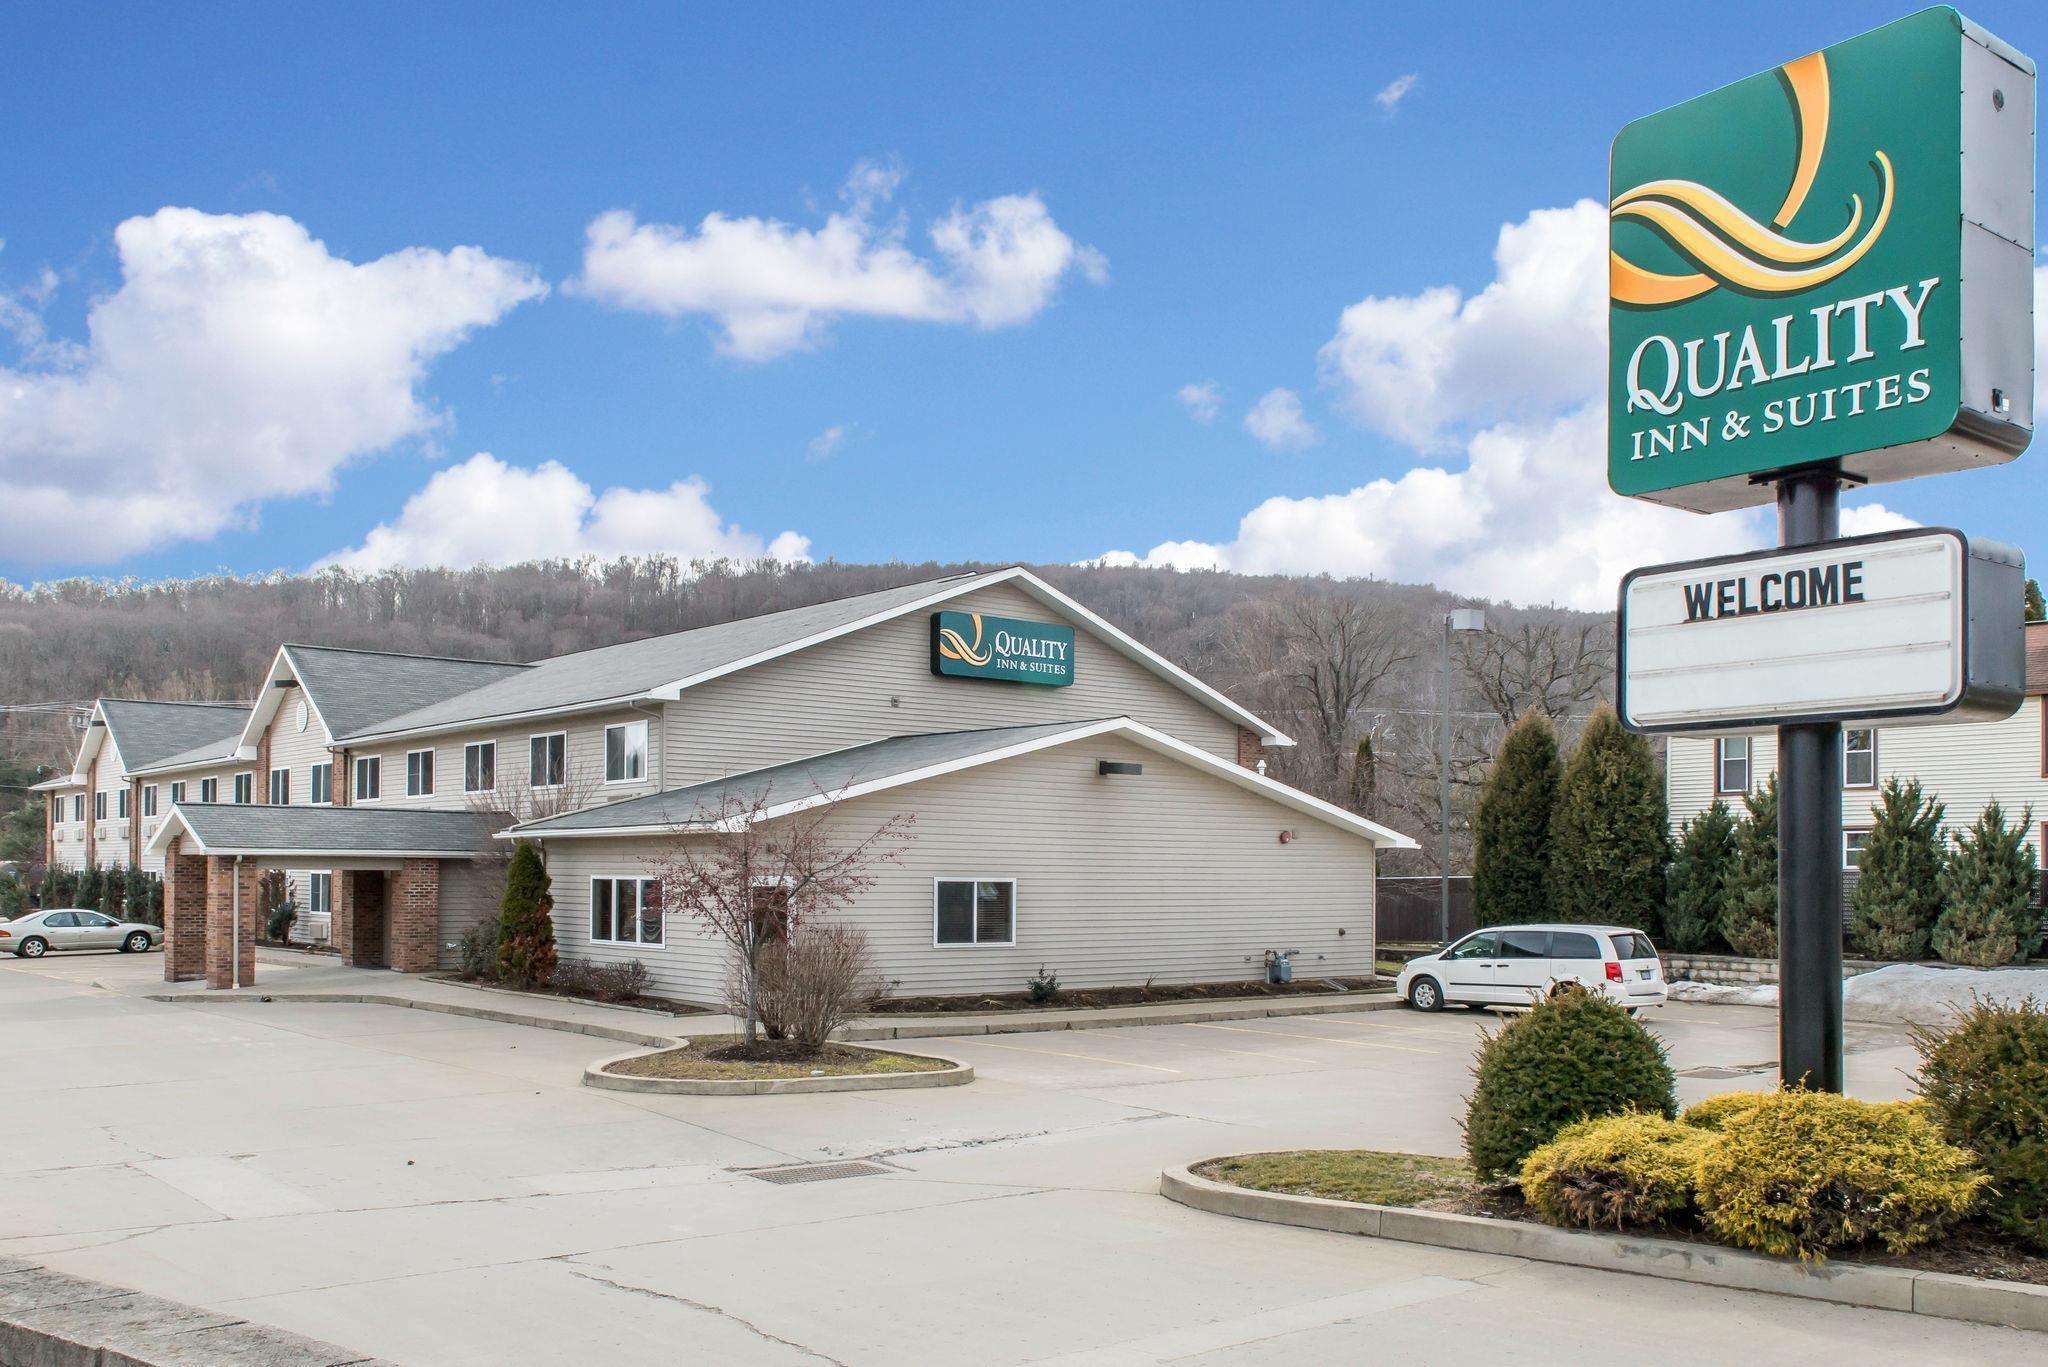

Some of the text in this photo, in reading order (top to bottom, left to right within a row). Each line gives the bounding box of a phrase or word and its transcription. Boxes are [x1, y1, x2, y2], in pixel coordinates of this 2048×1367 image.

[1626, 277, 1940, 415] QUALITY
[1630, 368, 1931, 461] INN & SUITES
[1683, 560, 1865, 623] WELCOME
[995, 631, 1068, 660] QUALITY
[997, 659, 1066, 675] INN & SUITES
